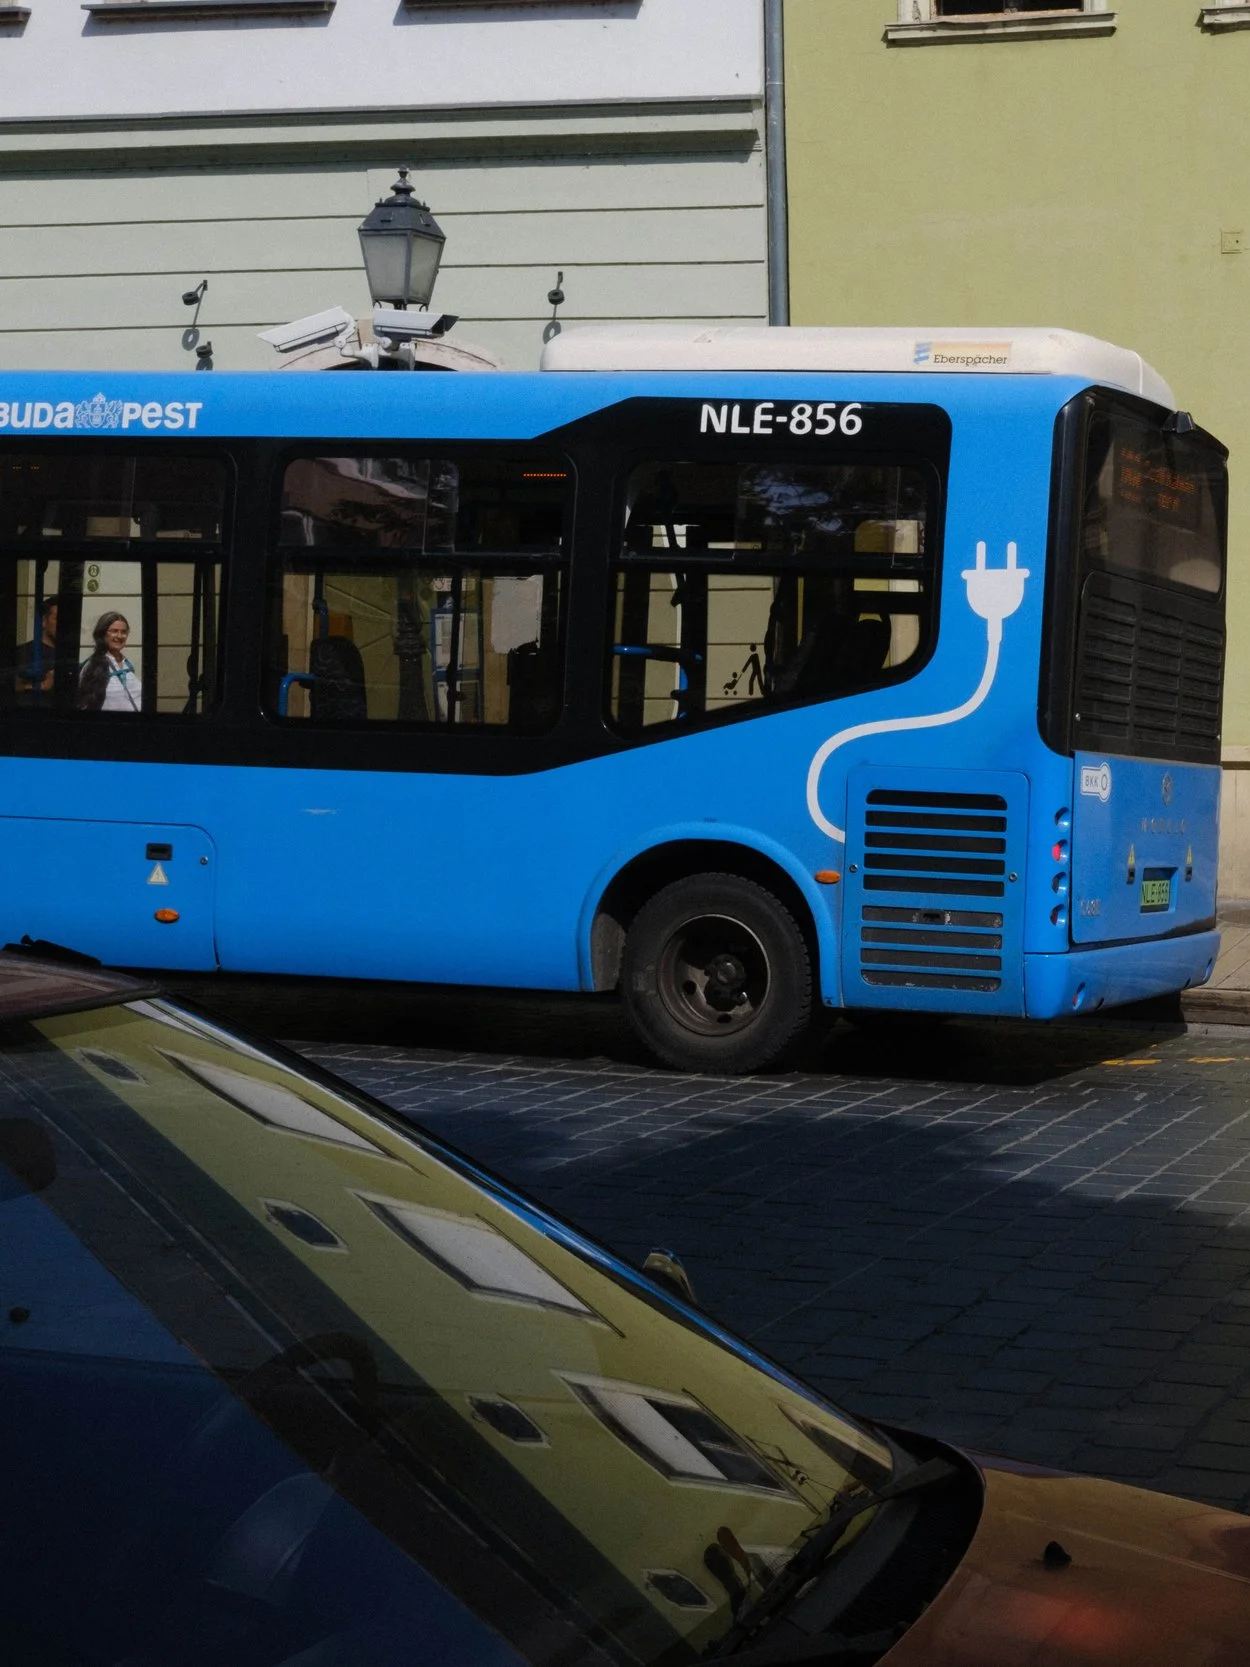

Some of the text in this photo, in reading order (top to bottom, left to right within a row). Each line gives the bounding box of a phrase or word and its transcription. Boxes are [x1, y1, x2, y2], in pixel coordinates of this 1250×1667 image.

[933, 354, 1007, 366] Eberspächer
[700, 402, 862, 436] NLE-856
[1085, 775, 1099, 787] BKK
